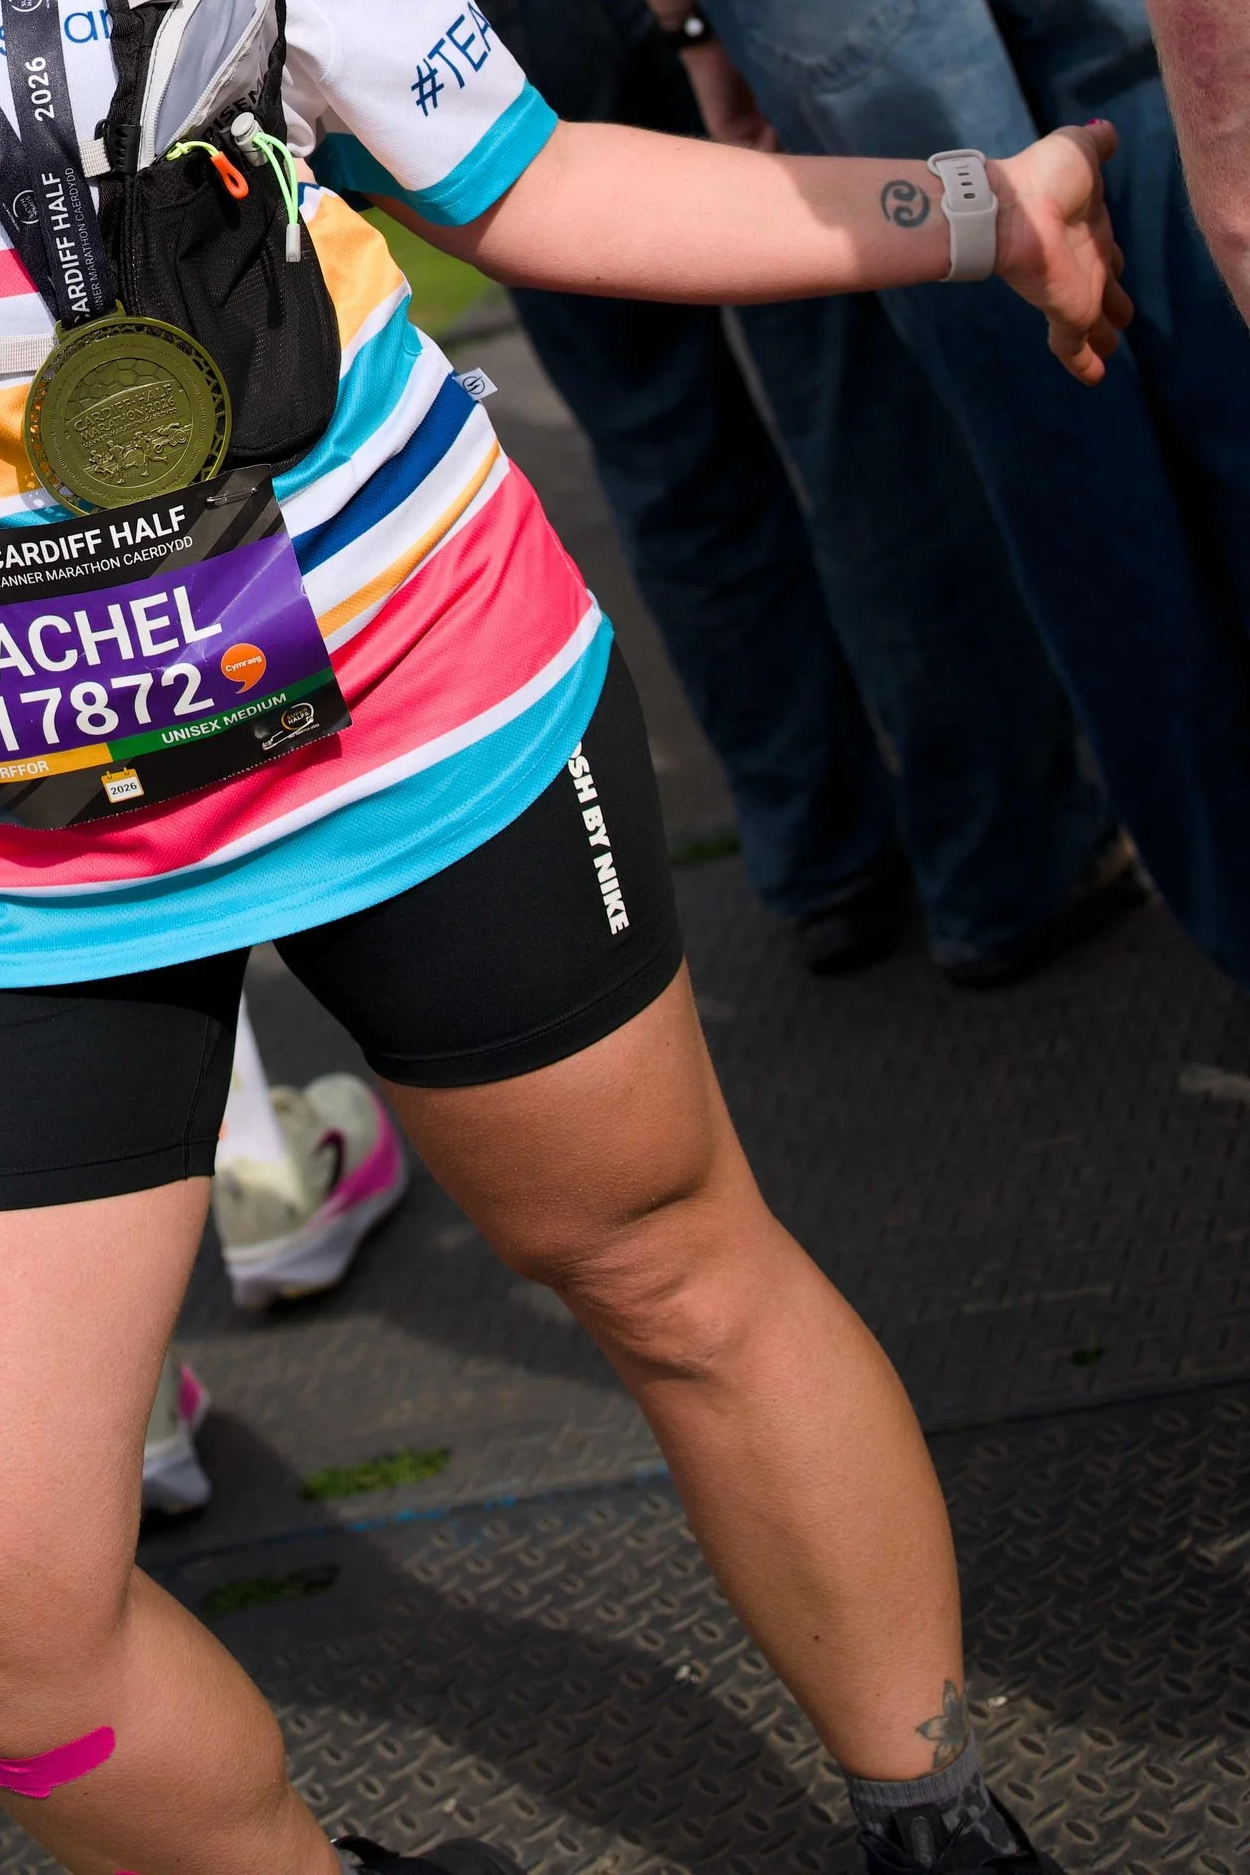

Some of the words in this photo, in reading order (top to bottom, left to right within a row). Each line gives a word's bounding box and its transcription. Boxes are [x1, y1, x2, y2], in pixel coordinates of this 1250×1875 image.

[25, 57, 55, 122] 2026
[42, 172, 71, 231] HALF
[65, 167, 84, 223] CAERDYDD
[77, 223, 99, 282] MARATHON
[55, 237, 91, 323] ARDIFF
[108, 504, 187, 549] HALF
[45, 559, 122, 581] MARATHON
[123, 536, 194, 566] CAERDYDD
[225, 654, 263, 673] Cymraeg
[162, 720, 222, 745] UNISEX
[223, 692, 288, 726] MEDIUM
[110, 782, 139, 796] 2026
[582, 805, 611, 847] BY
[593, 852, 630, 936] NIKE
